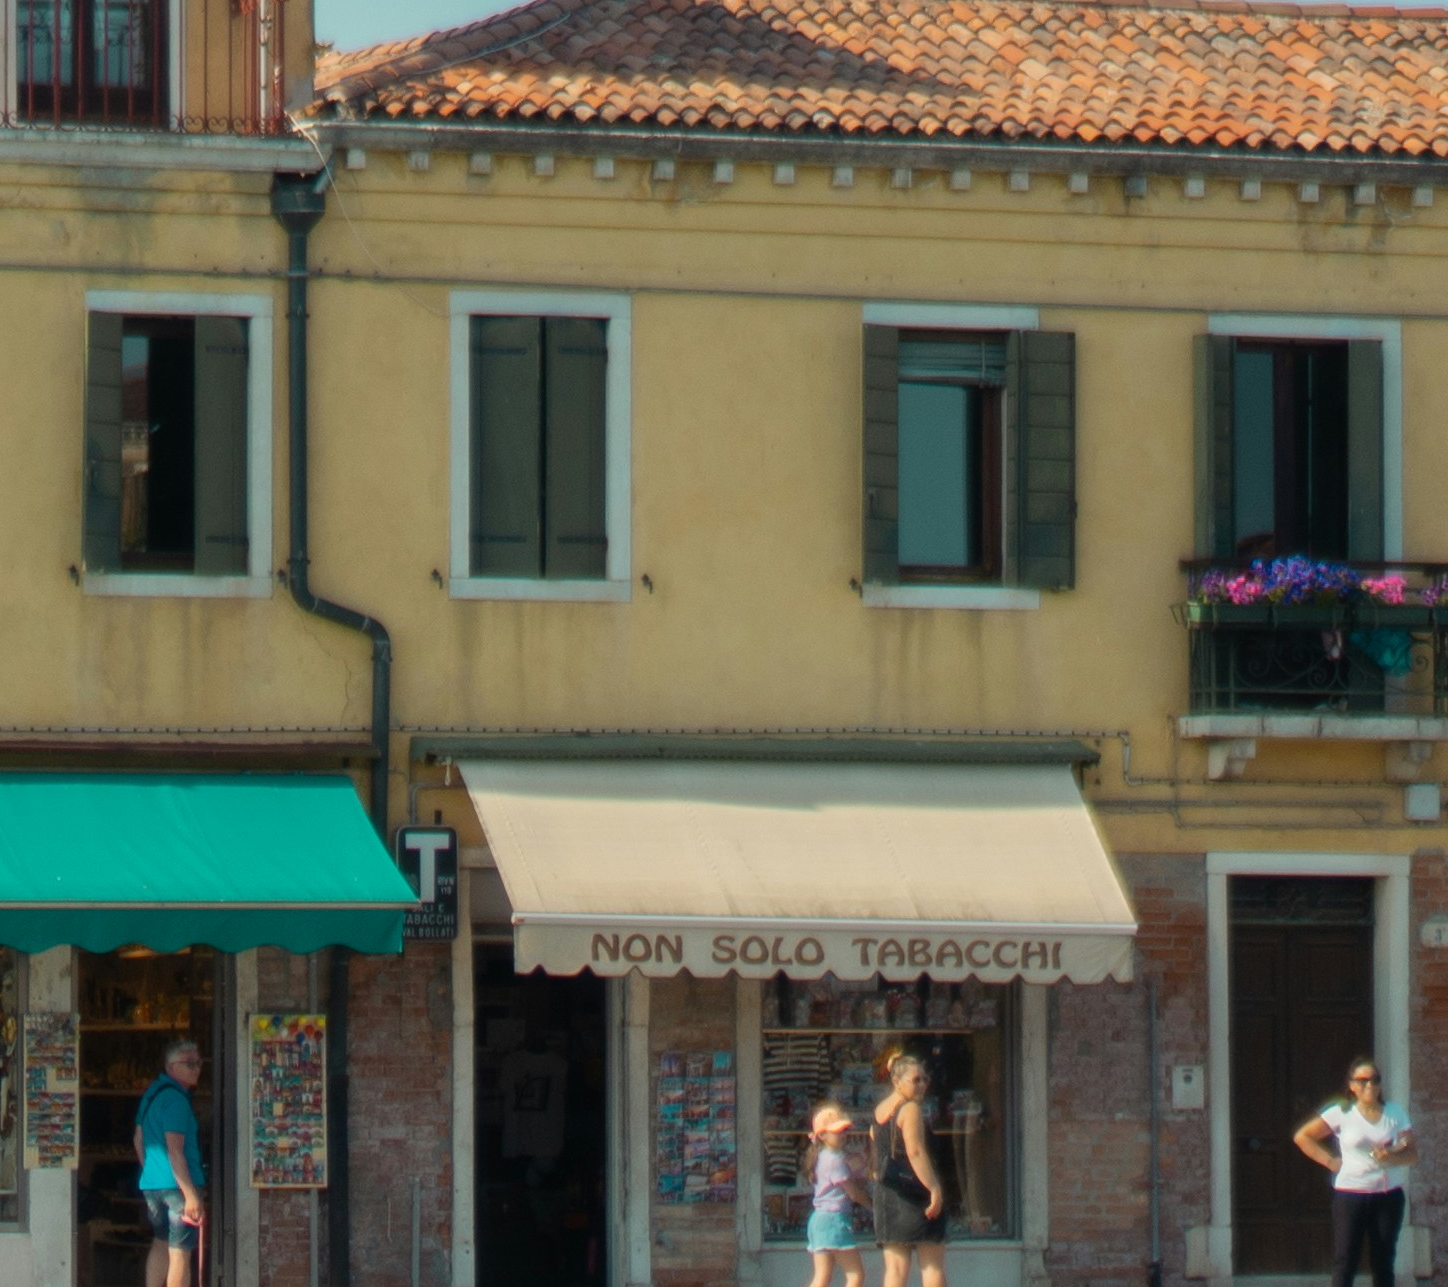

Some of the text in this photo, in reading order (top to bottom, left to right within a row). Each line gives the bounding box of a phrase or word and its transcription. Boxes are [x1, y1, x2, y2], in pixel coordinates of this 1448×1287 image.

[405, 833, 450, 903] T
[591, 932, 1063, 970] NON SOLO TABACCHI
